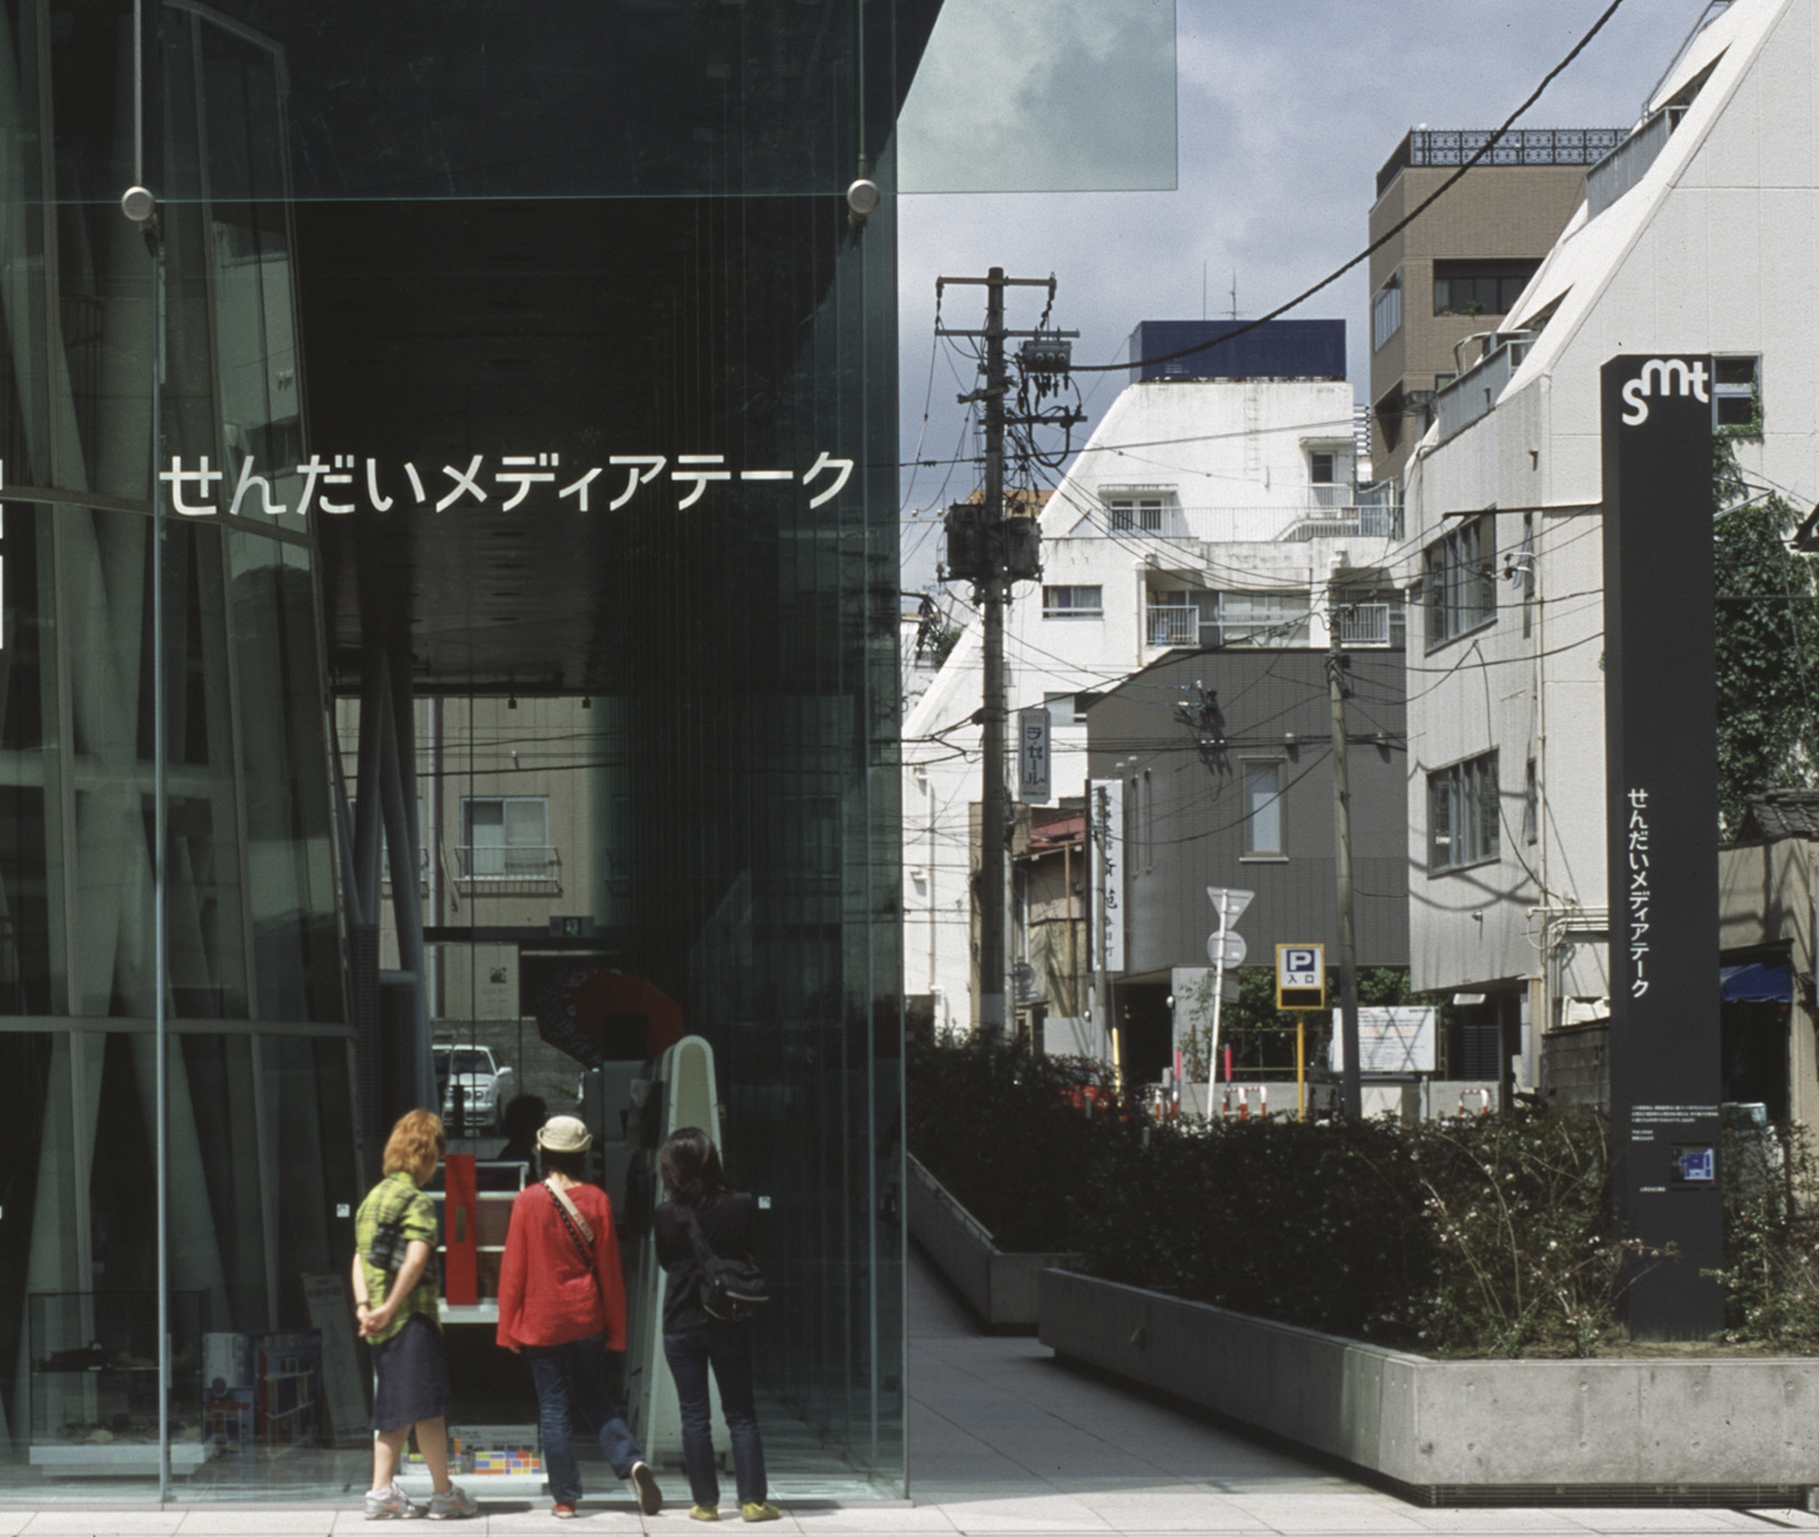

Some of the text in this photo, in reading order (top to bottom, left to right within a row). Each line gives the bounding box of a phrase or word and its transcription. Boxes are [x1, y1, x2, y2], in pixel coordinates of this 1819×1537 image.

[1622, 358, 1708, 426] smt
[159, 451, 854, 516] せんだいメディアテーク
[1627, 788, 1650, 999] せんだいメディアテーク
[1288, 974, 1315, 984] 入口
[1289, 951, 1312, 971] P
